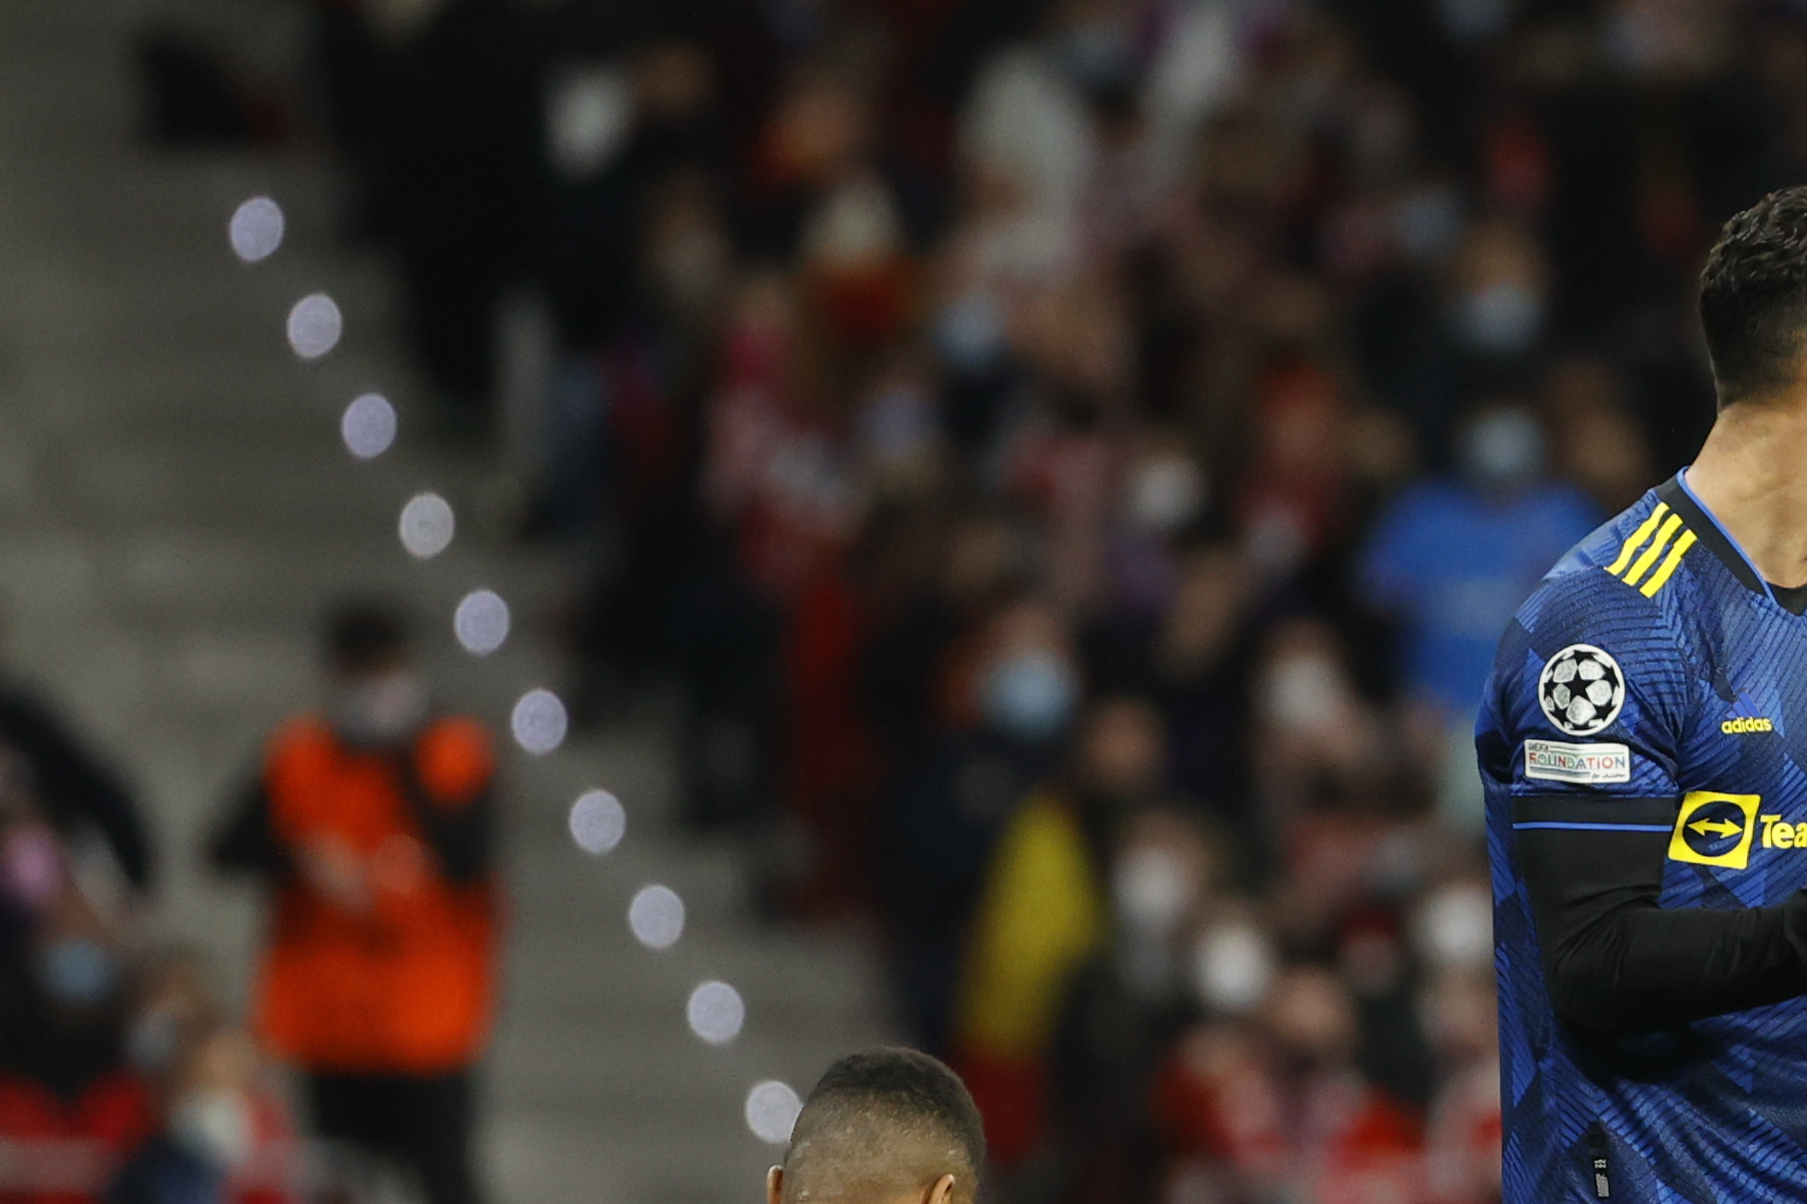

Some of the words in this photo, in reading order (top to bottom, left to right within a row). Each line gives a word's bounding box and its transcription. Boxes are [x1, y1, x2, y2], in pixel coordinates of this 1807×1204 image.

[1721, 717, 1773, 734] adidas
[1528, 742, 1549, 752] UEFA
[1529, 752, 1626, 769] FOUNDATION
